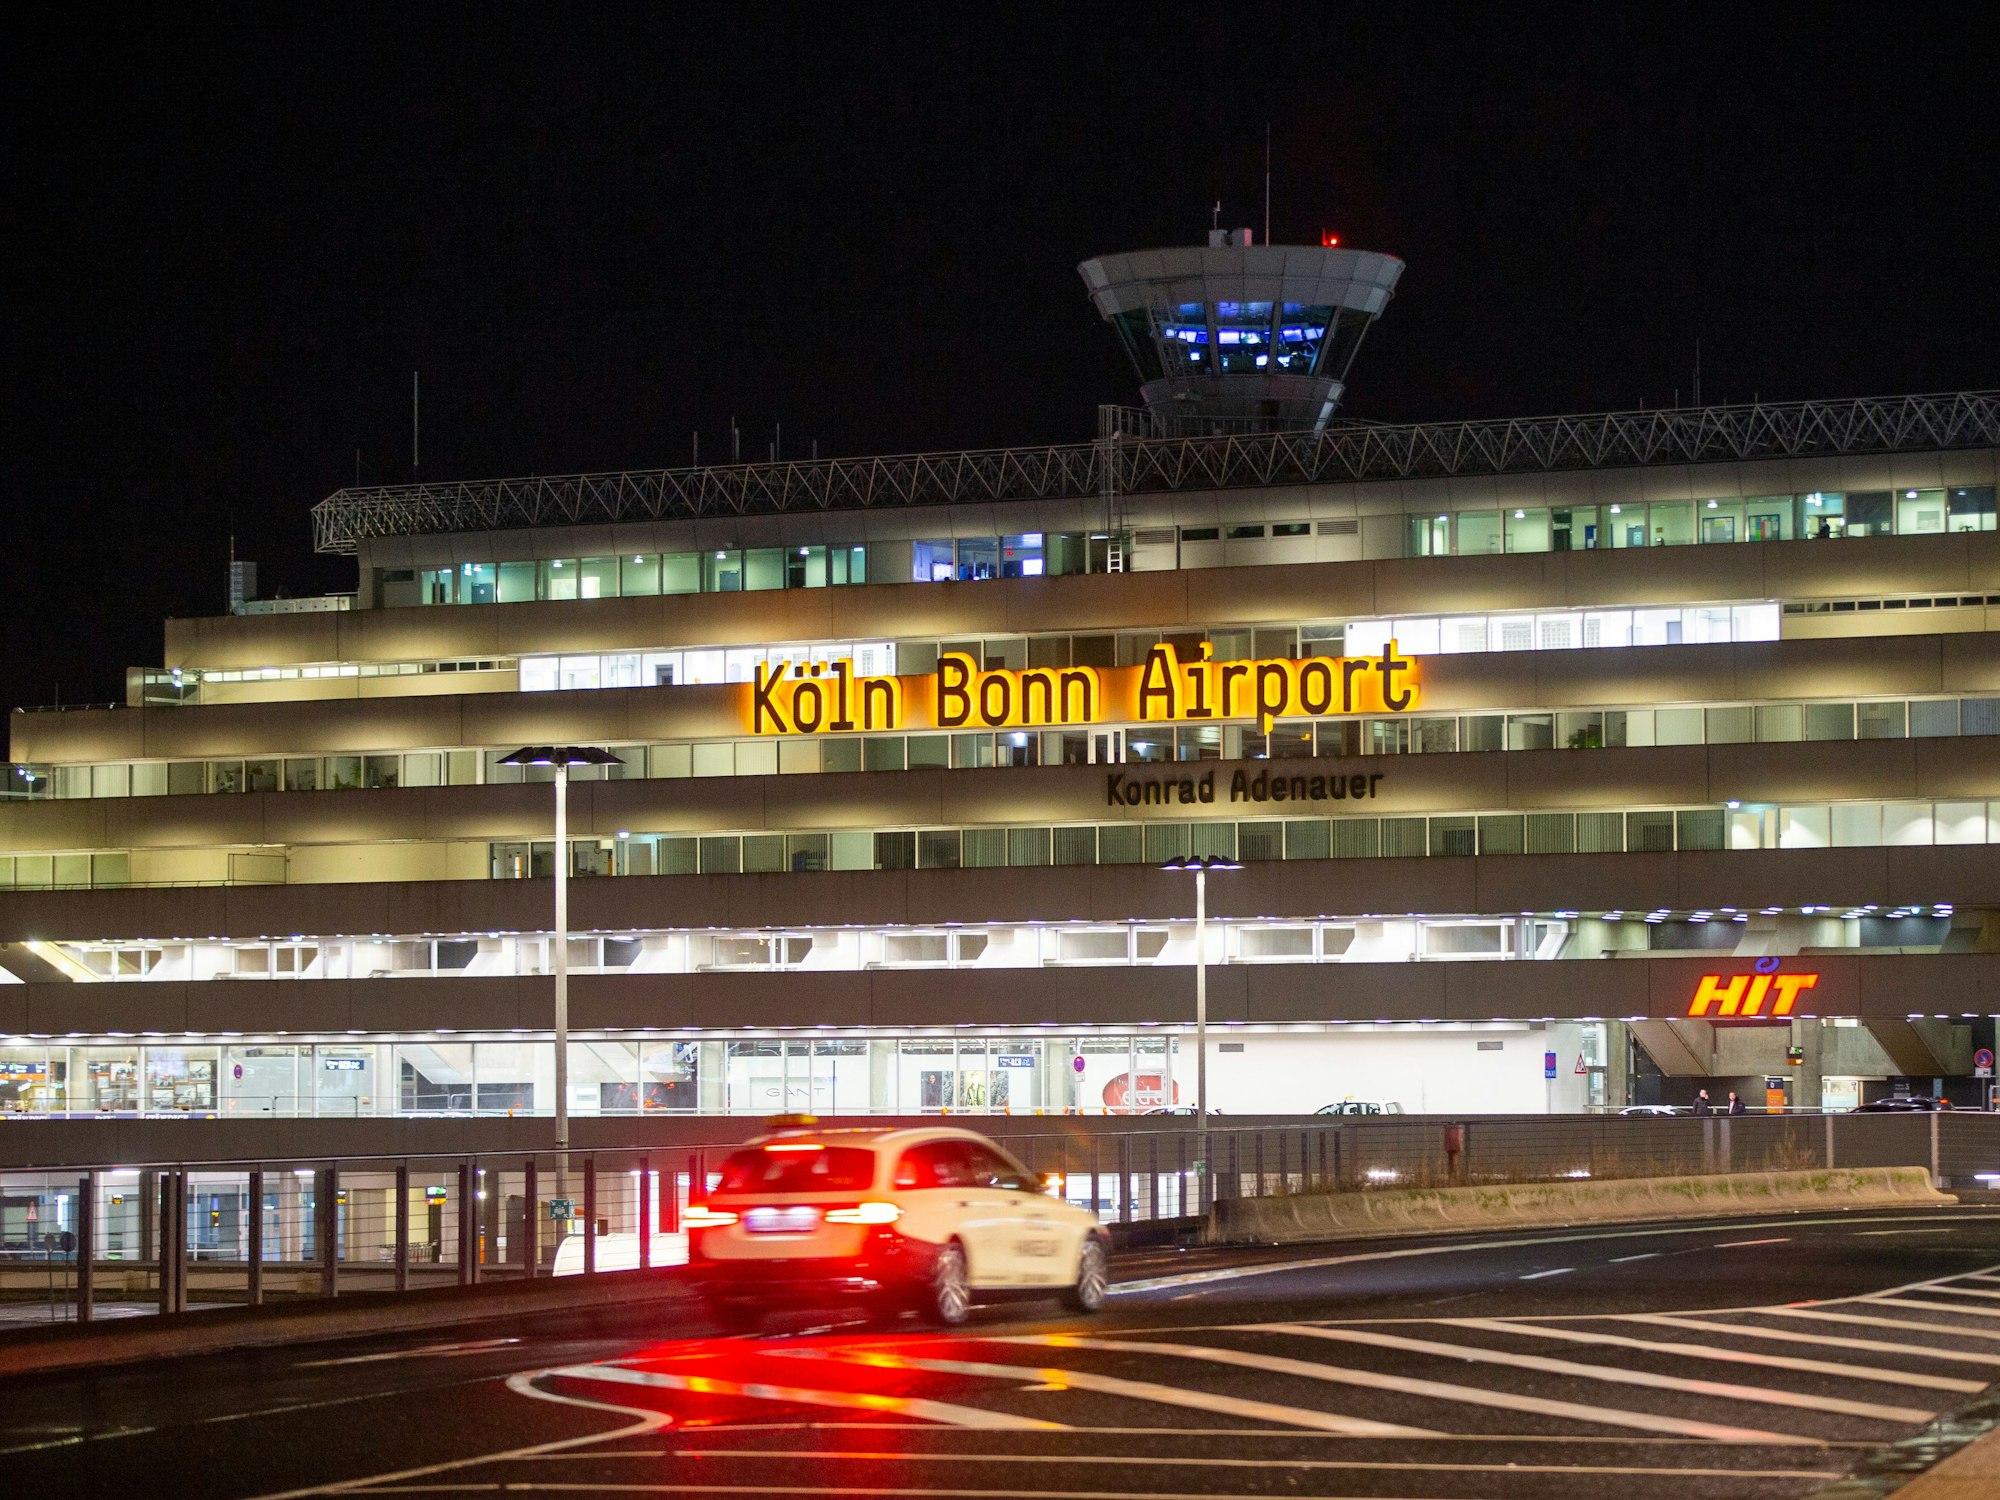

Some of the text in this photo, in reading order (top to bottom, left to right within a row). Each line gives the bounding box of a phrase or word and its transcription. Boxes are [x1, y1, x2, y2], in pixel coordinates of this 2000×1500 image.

[754, 642, 1413, 736] Köln Bonn Airport
[1107, 769, 1384, 806] Konrad Adenauer
[1687, 957, 1819, 1016] HIT
[766, 1087, 824, 1097] GANT
